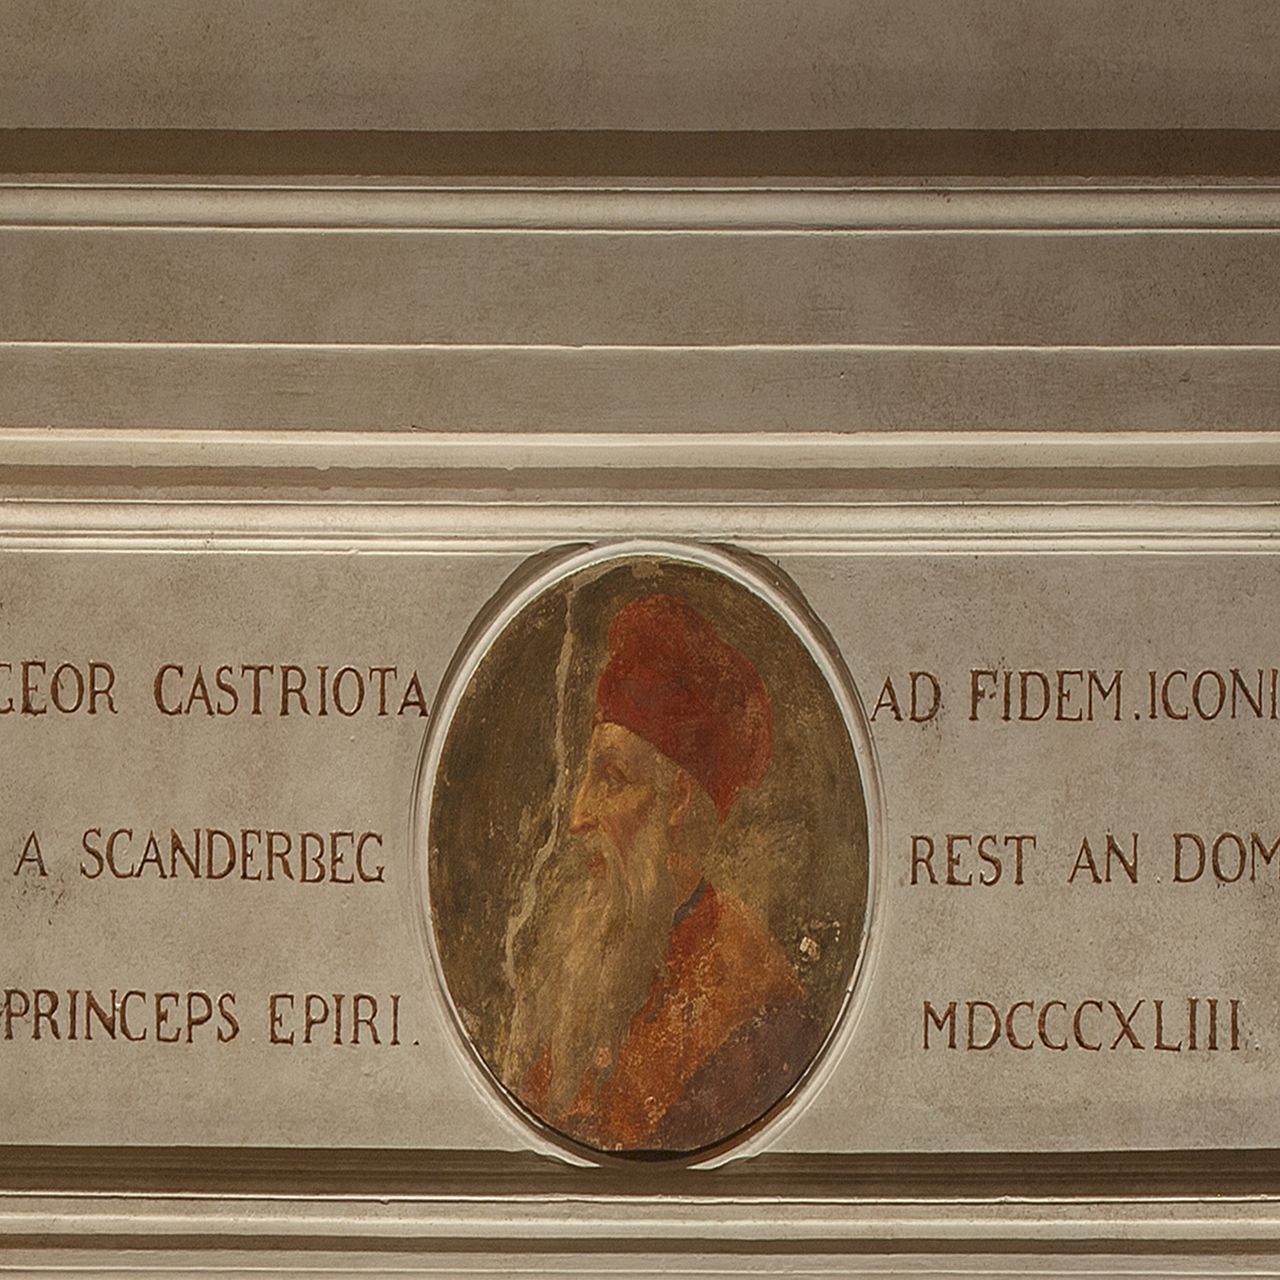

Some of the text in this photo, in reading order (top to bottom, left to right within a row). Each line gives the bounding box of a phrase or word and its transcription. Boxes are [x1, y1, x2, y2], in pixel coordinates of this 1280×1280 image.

[153, 663, 429, 717] CASTRIOTA
[870, 671, 942, 722] AD
[14, 828, 385, 883] A SCANDERBEG
[909, 833, 1036, 886] REST
[1067, 832, 1139, 884] AN
[4, 989, 240, 1043] PRINCEPS
